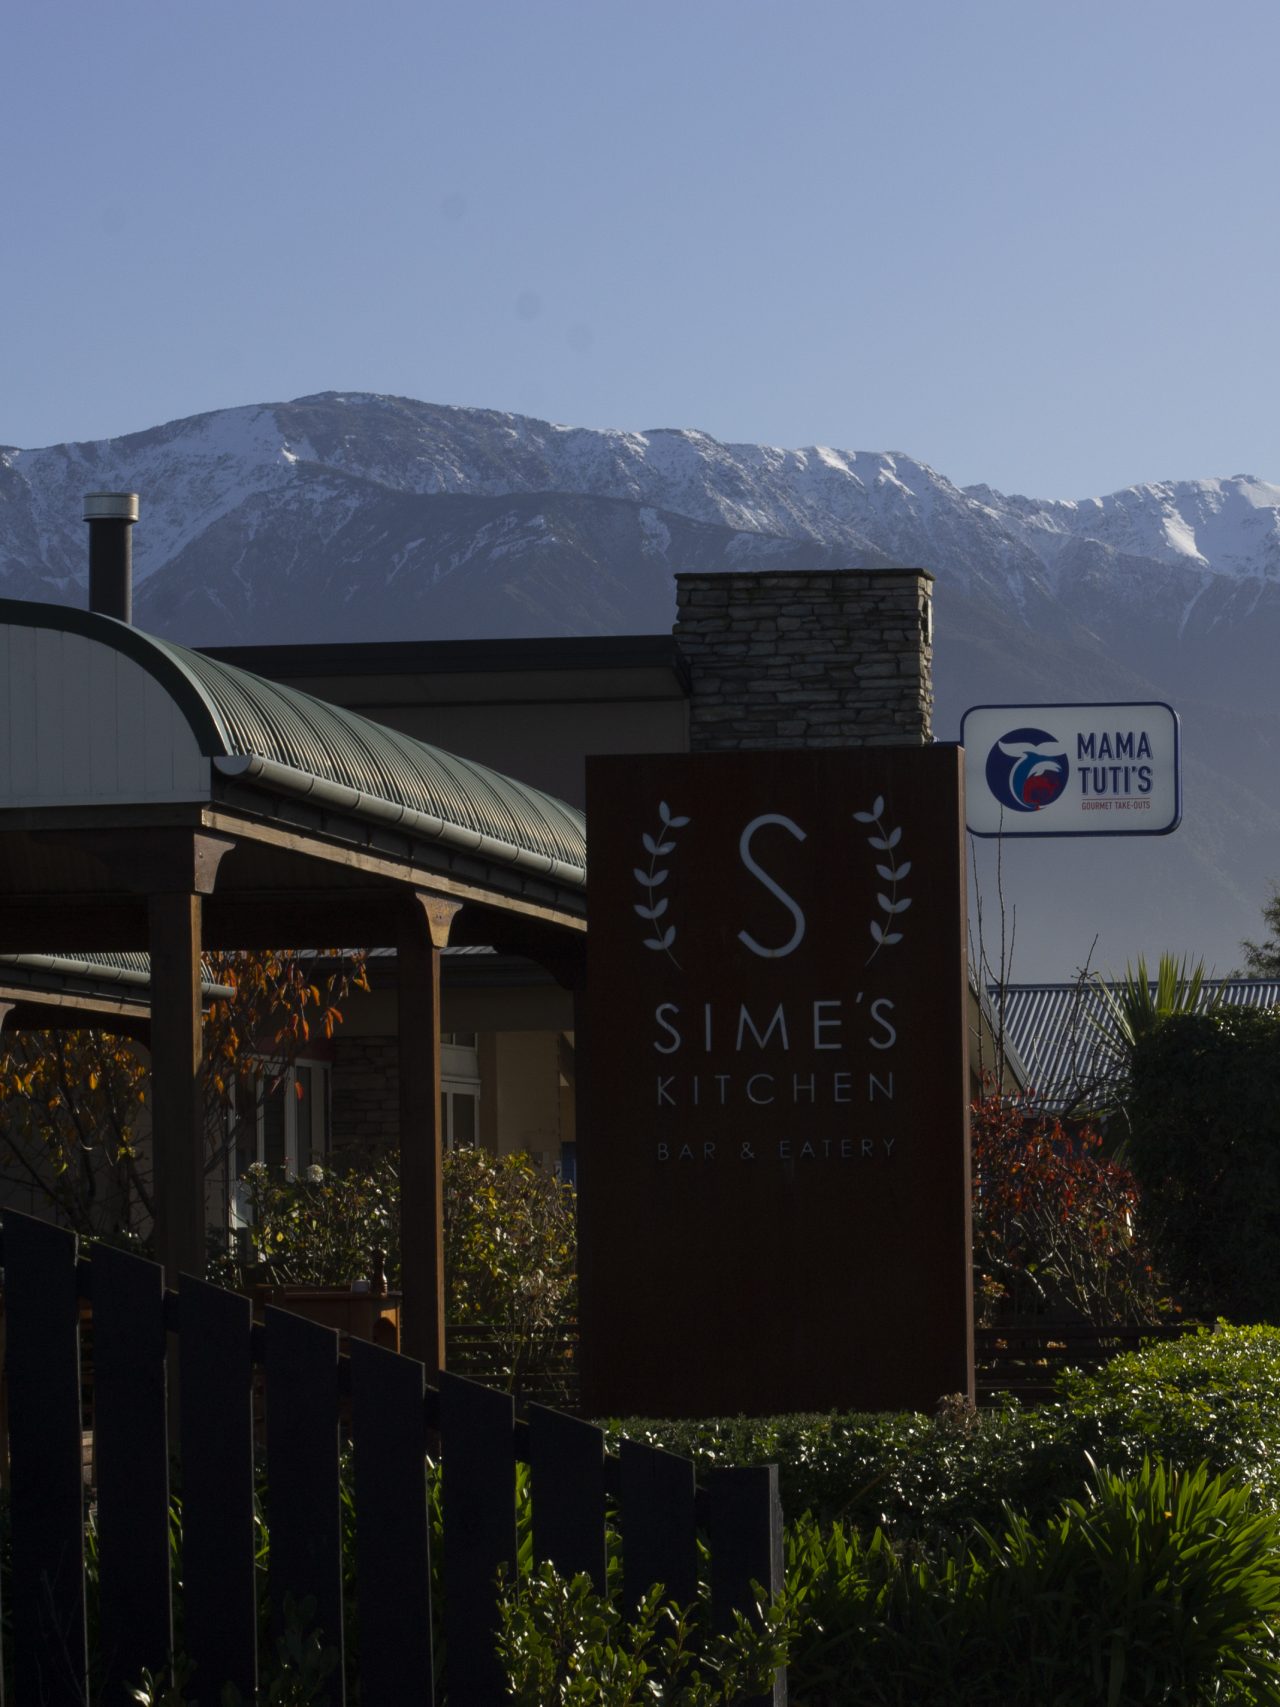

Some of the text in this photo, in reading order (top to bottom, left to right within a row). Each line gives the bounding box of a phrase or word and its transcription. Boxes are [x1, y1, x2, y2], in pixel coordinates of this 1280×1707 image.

[1077, 731, 1153, 760] MAMA
[1077, 765, 1153, 795] TUTI'S
[1081, 800, 1151, 811] GOURMET TAKE-OUTS
[738, 813, 808, 959] S
[653, 991, 899, 1055] SIME'S
[656, 1072, 895, 1107] KITCHEN
[656, 1138, 897, 1162] BAR & EATERY
